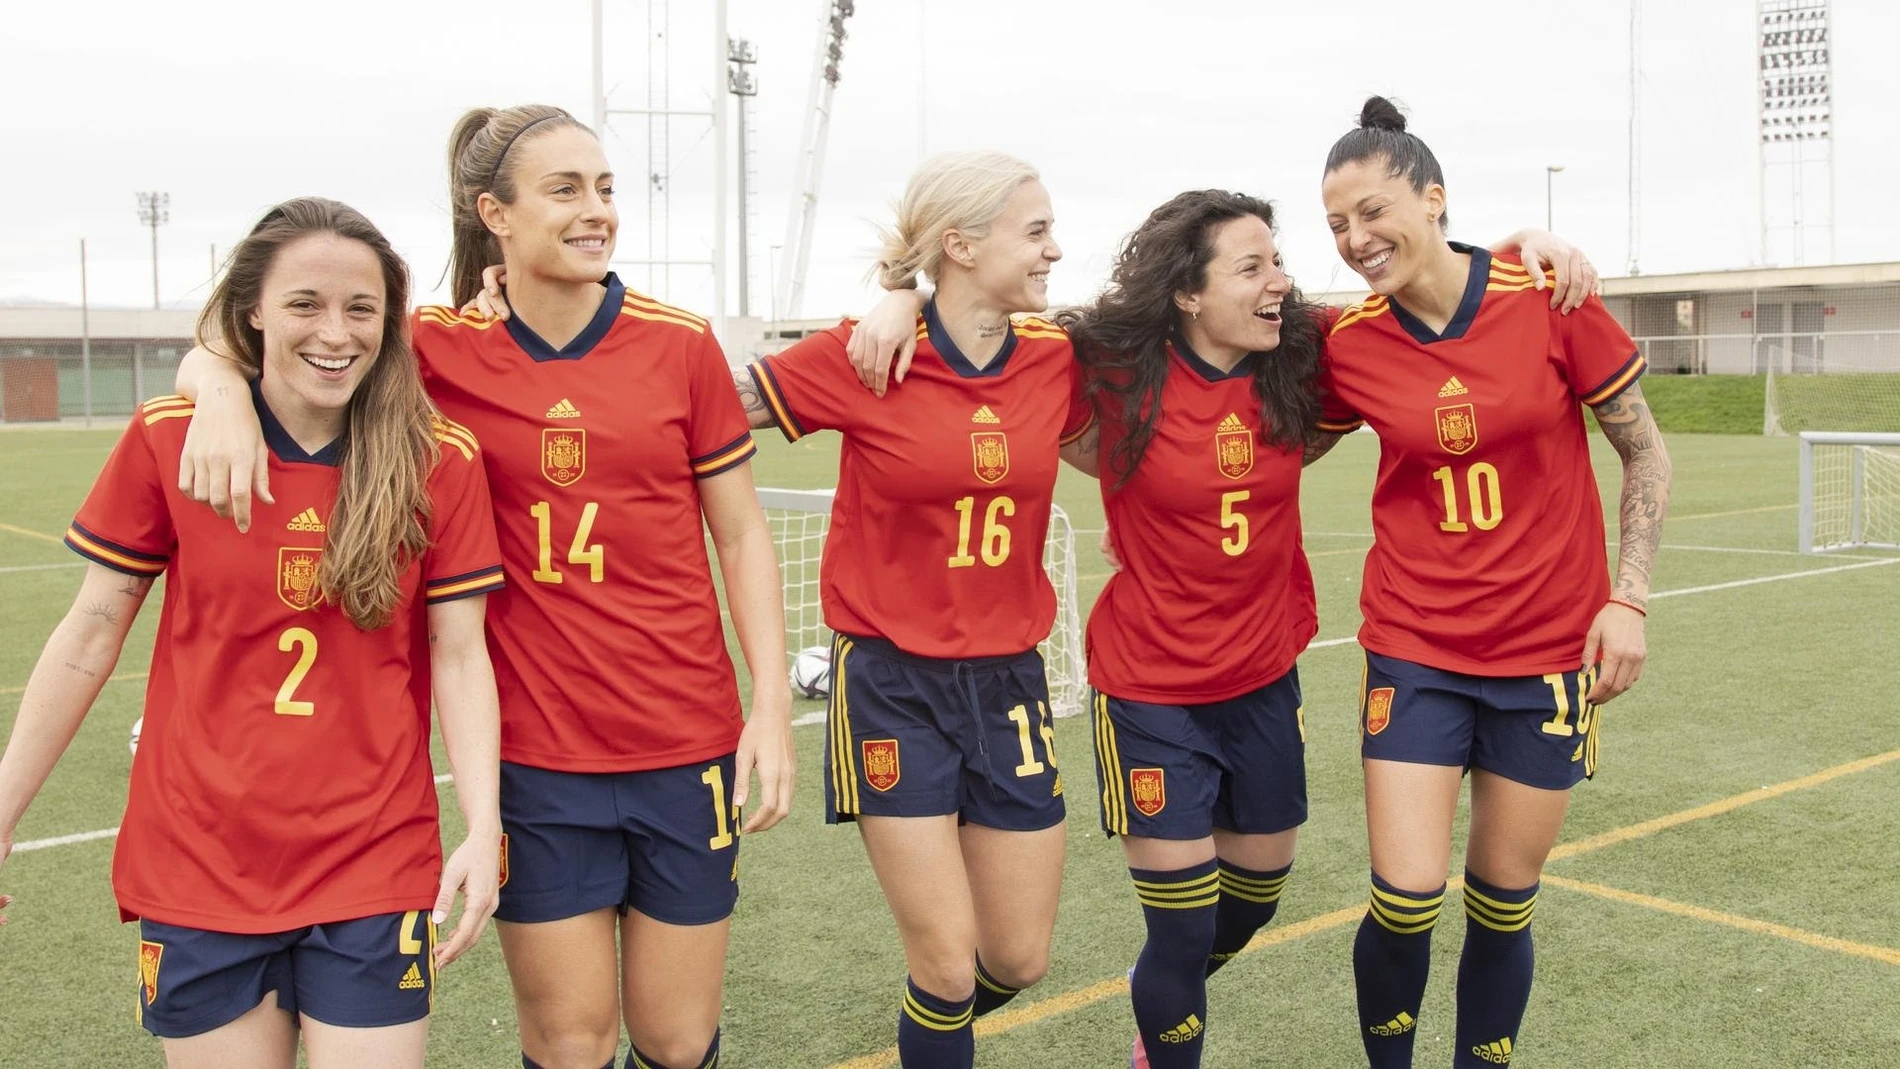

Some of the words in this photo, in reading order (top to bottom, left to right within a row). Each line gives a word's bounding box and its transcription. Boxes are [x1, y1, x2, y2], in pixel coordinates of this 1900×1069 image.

[1438, 387, 1468, 398] adidas
[546, 411, 581, 419] adidas
[972, 416, 1001, 424] adidas
[1433, 462, 1503, 532] 10
[287, 522, 326, 532] adidas
[531, 501, 604, 584] 14
[948, 496, 1015, 568] 16
[1221, 490, 1250, 556] 5
[275, 627, 318, 716] 2
[1542, 666, 1597, 736] 10
[702, 765, 740, 850] 1
[399, 979, 425, 989] adidas
[1159, 1022, 1203, 1043] adidas
[1472, 1047, 1512, 1064] adida
